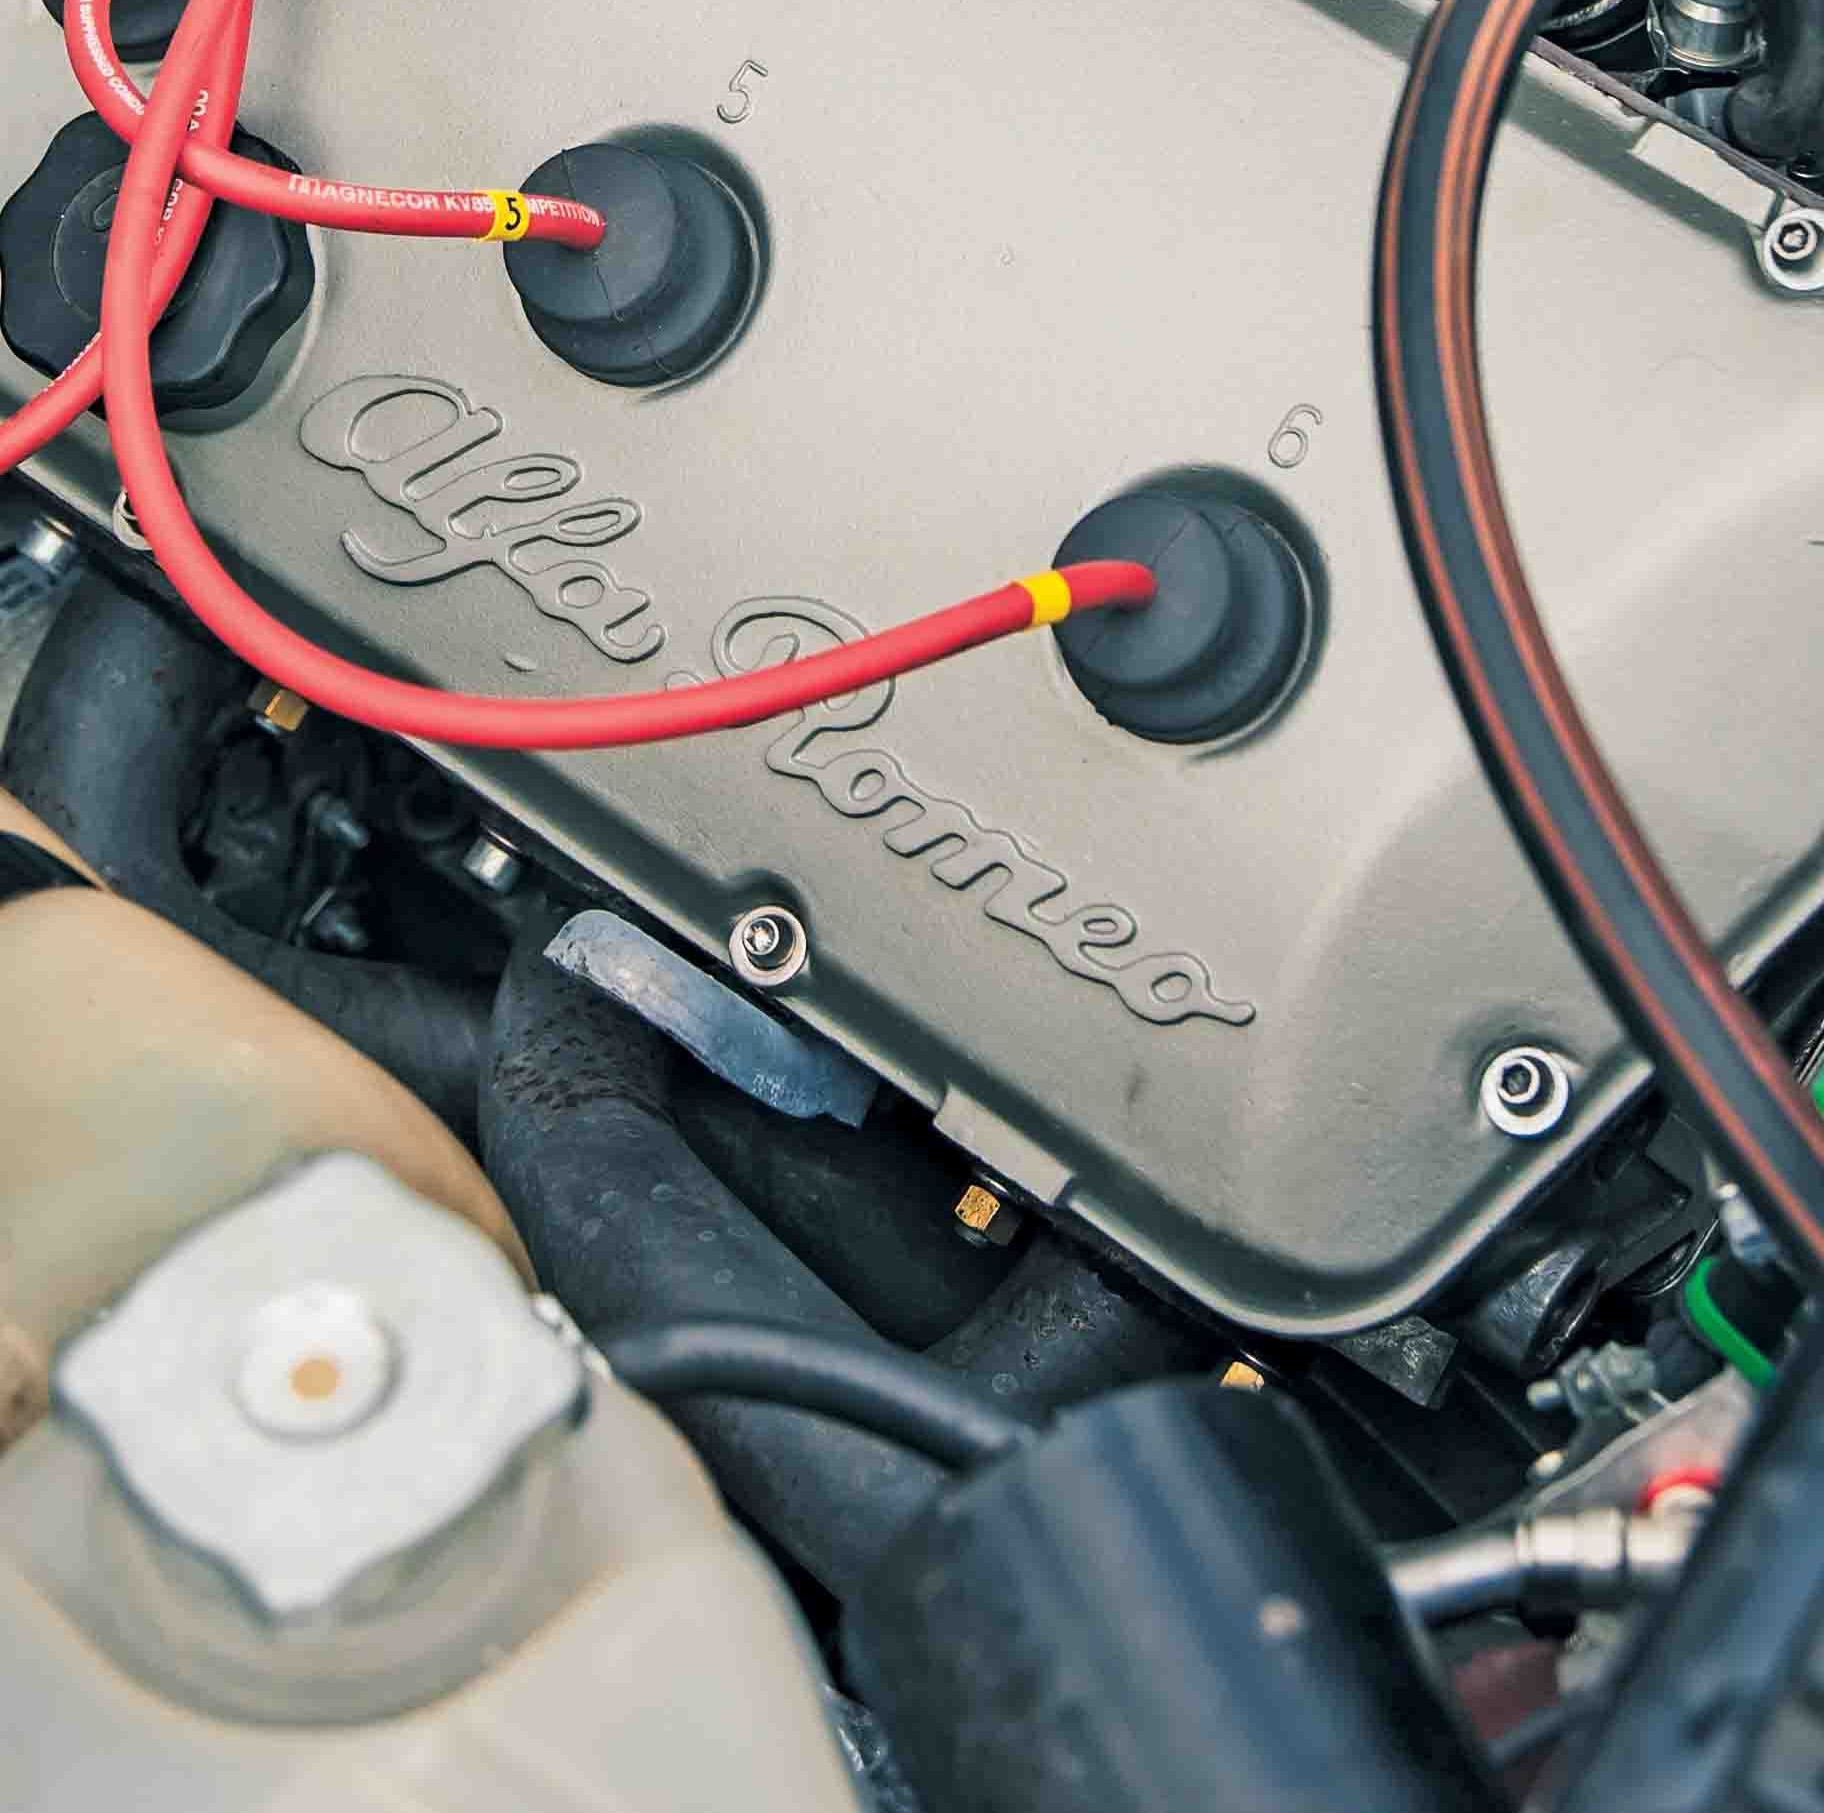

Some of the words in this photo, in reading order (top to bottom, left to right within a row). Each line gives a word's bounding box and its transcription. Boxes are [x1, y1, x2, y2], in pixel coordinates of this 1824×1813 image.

[716, 58, 770, 125] 5
[287, 173, 442, 213] MAGNECOR
[444, 193, 495, 213] KV85
[527, 196, 601, 229] MPETITION
[504, 196, 522, 231] 5
[1267, 402, 1325, 470] 6
[297, 372, 666, 663] Alfa
[708, 594, 1258, 1028] Romeo
